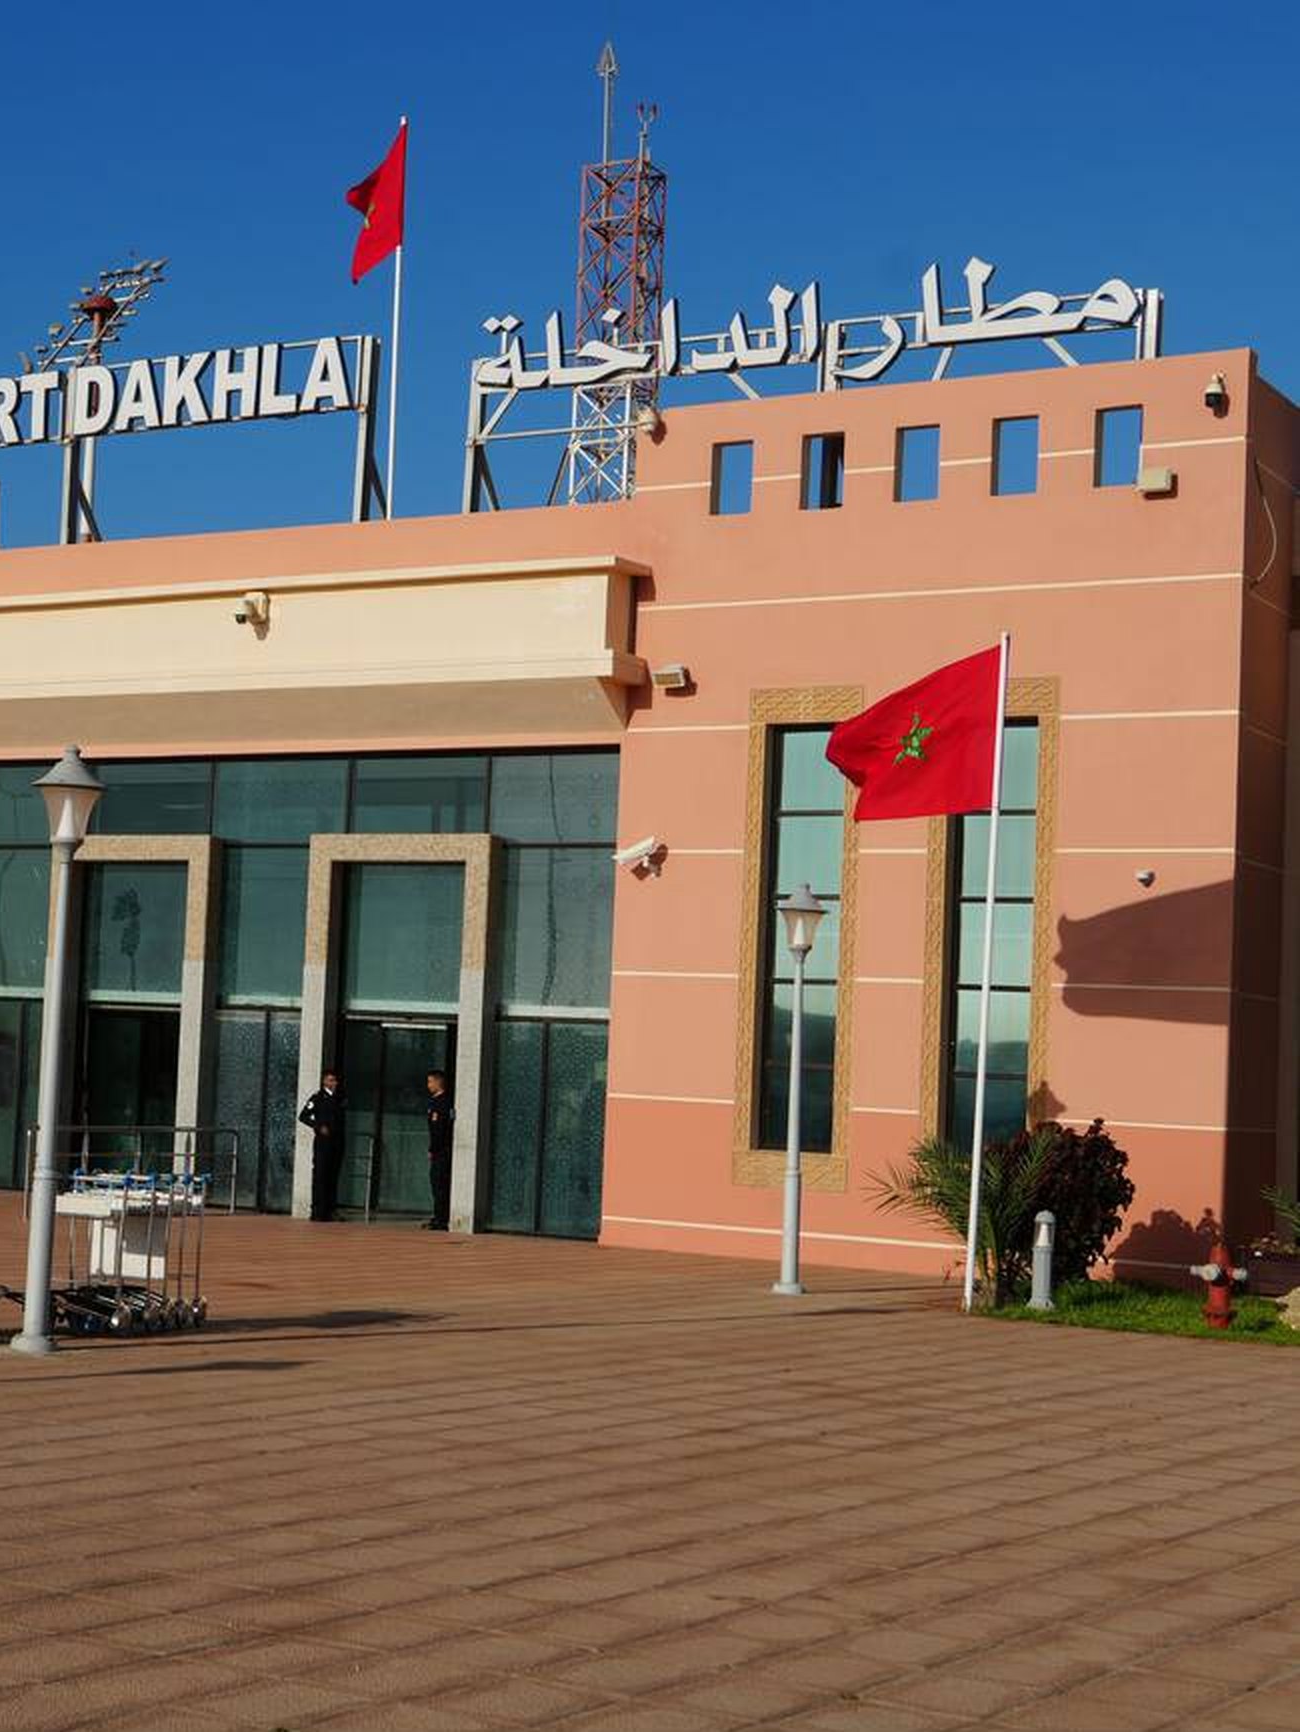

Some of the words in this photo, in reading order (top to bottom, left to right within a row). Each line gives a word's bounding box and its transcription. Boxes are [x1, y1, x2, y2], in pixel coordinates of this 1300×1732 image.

[476, 281, 820, 389] الداخلة
[835, 257, 1142, 380] مطار
[73, 337, 352, 437] DAKHLA
